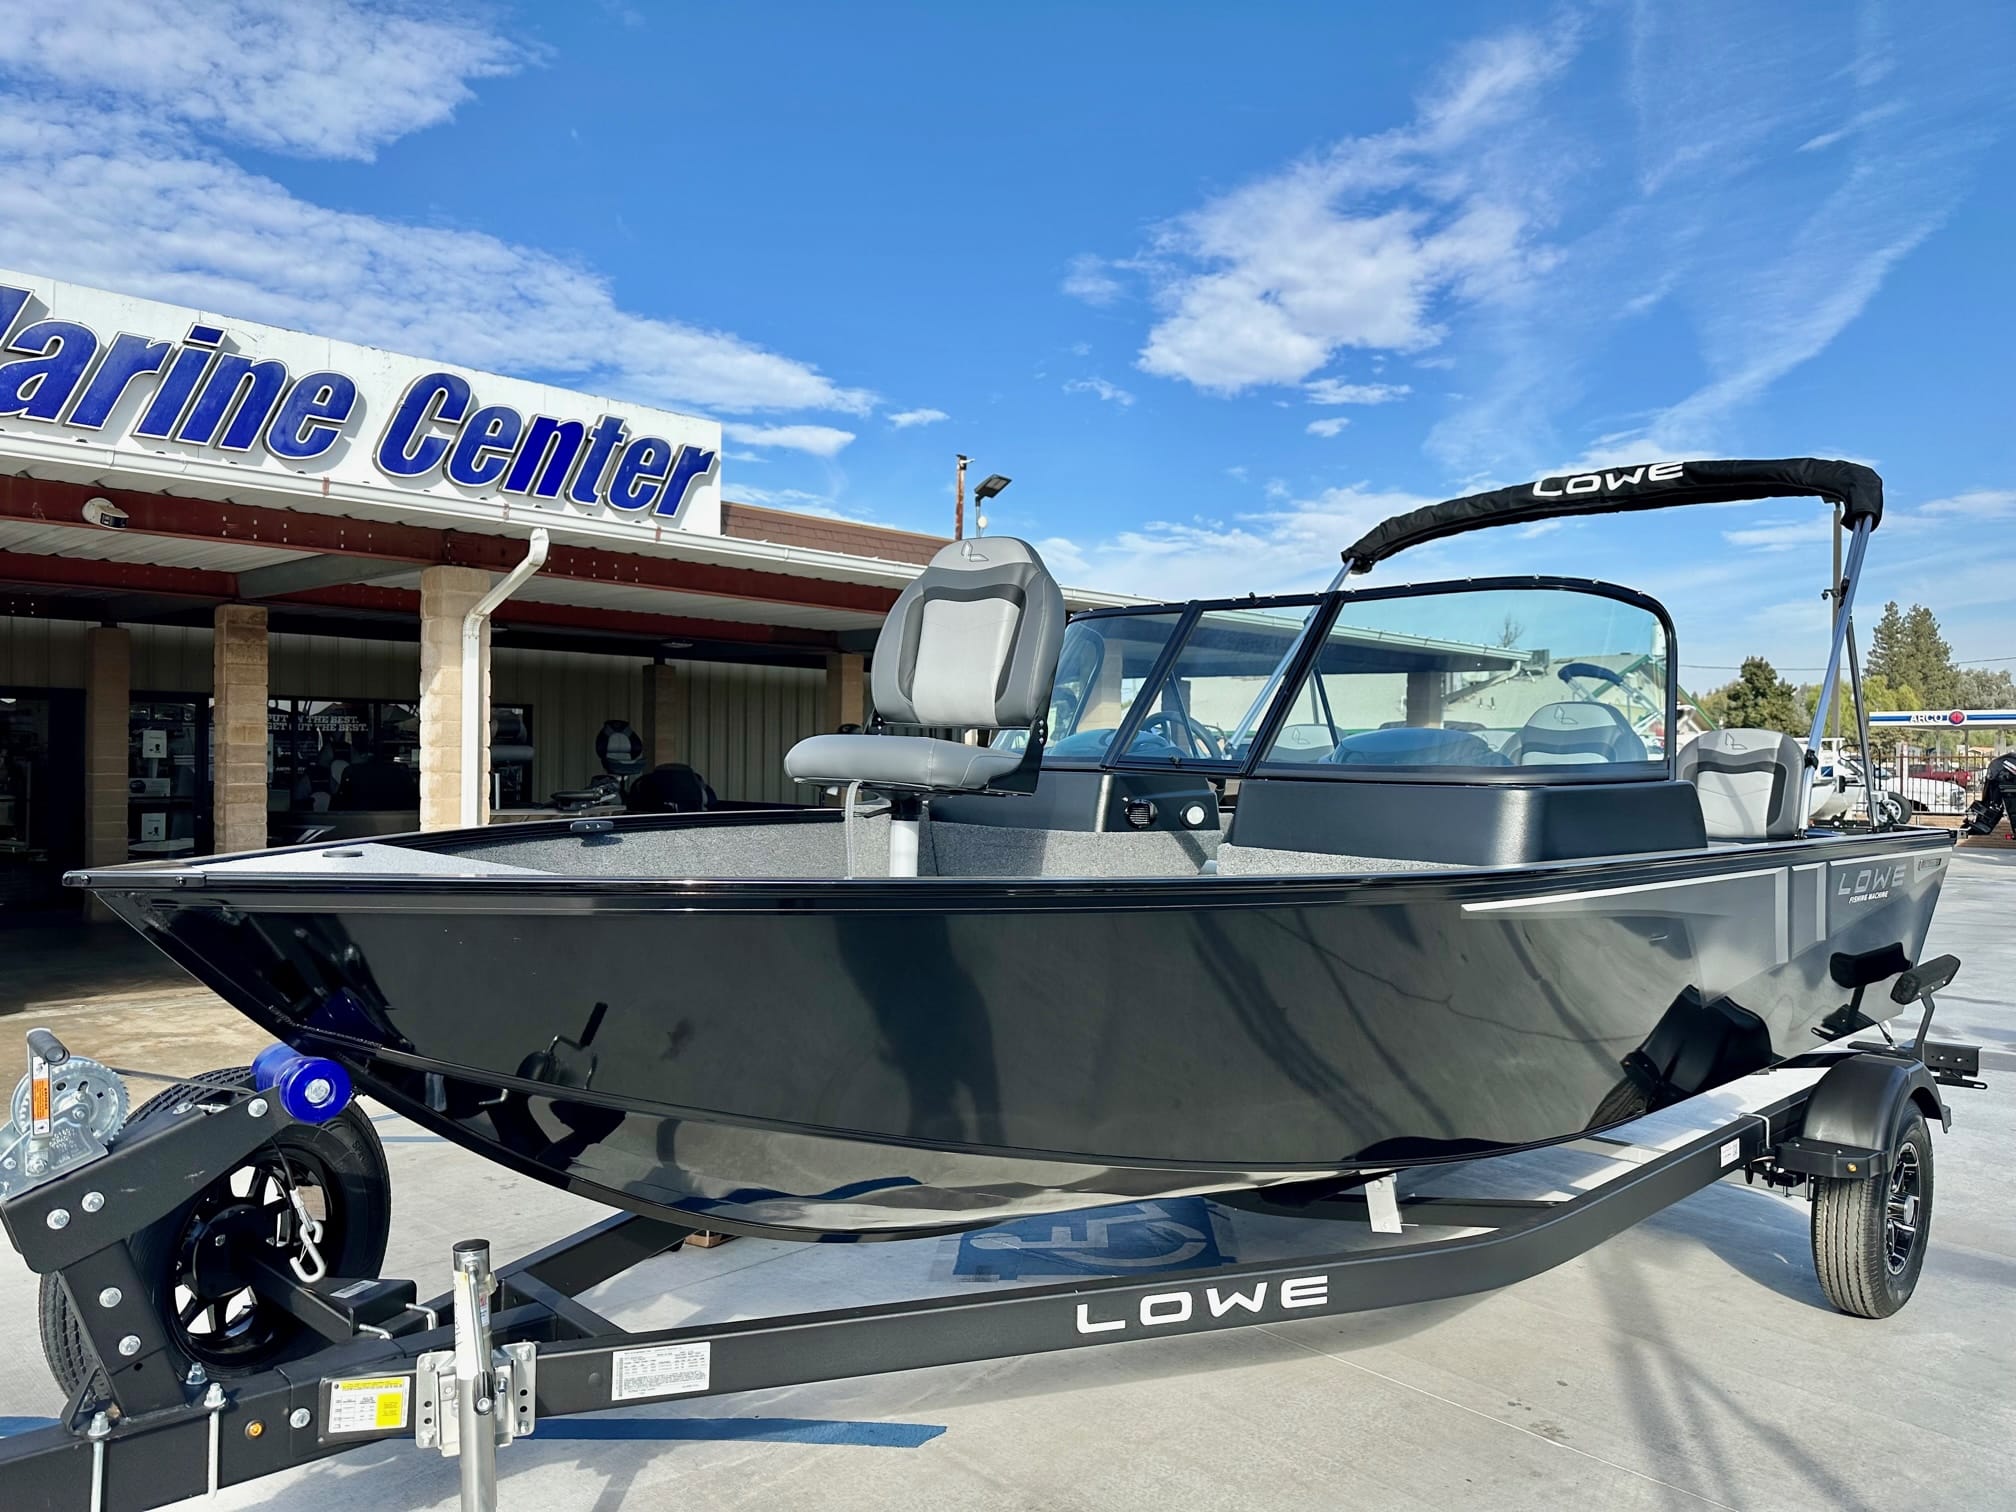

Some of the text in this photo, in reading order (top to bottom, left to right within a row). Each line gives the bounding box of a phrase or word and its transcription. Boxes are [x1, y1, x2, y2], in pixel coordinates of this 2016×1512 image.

[374, 372, 716, 518] Center
[1532, 461, 1684, 497] LOWE
[306, 716, 329, 724] THE
[314, 723, 337, 732] THE
[1910, 713, 1945, 723] ARCO
[1838, 864, 1907, 895] LOWE
[1848, 890, 1889, 904] FISHING MACHINE
[1076, 1275, 1328, 1334] LOWE
